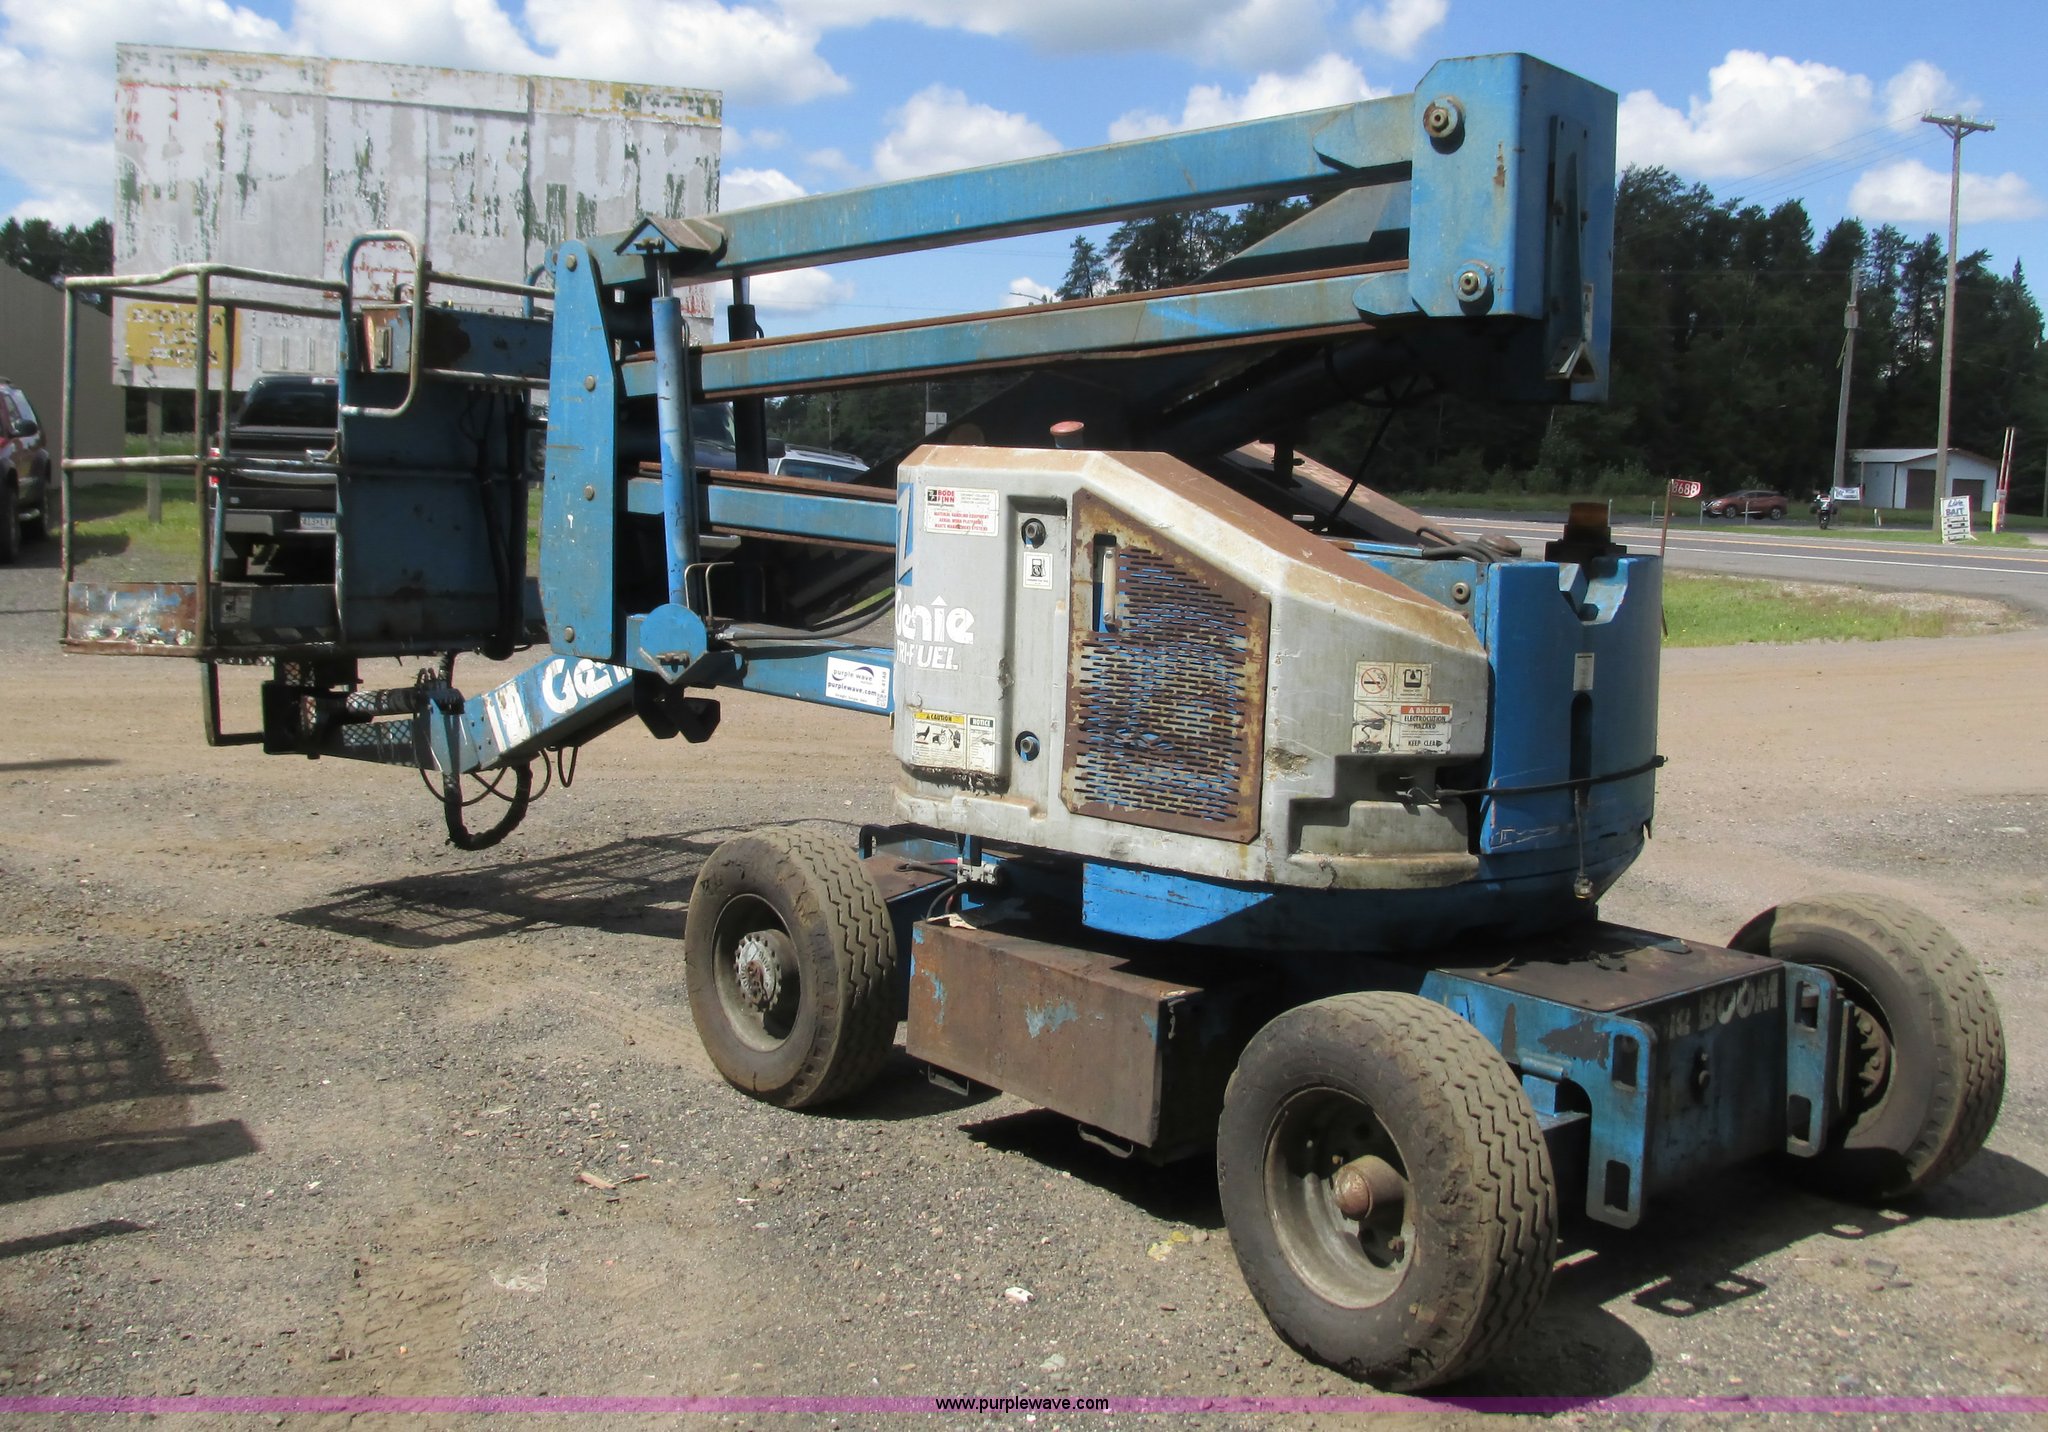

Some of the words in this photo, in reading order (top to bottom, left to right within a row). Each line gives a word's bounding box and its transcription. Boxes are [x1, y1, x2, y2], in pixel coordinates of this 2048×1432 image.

[895, 588, 975, 645] Genie
[833, 669, 854, 678] purple
[856, 673, 873, 682] wave
[827, 681, 877, 697] purplewave.com
[1416, 706, 1442, 714] DANGER
[930, 713, 952, 721] CAUTION
[972, 718, 991, 727] NOTICE
[1698, 973, 1779, 1032] BOOM
